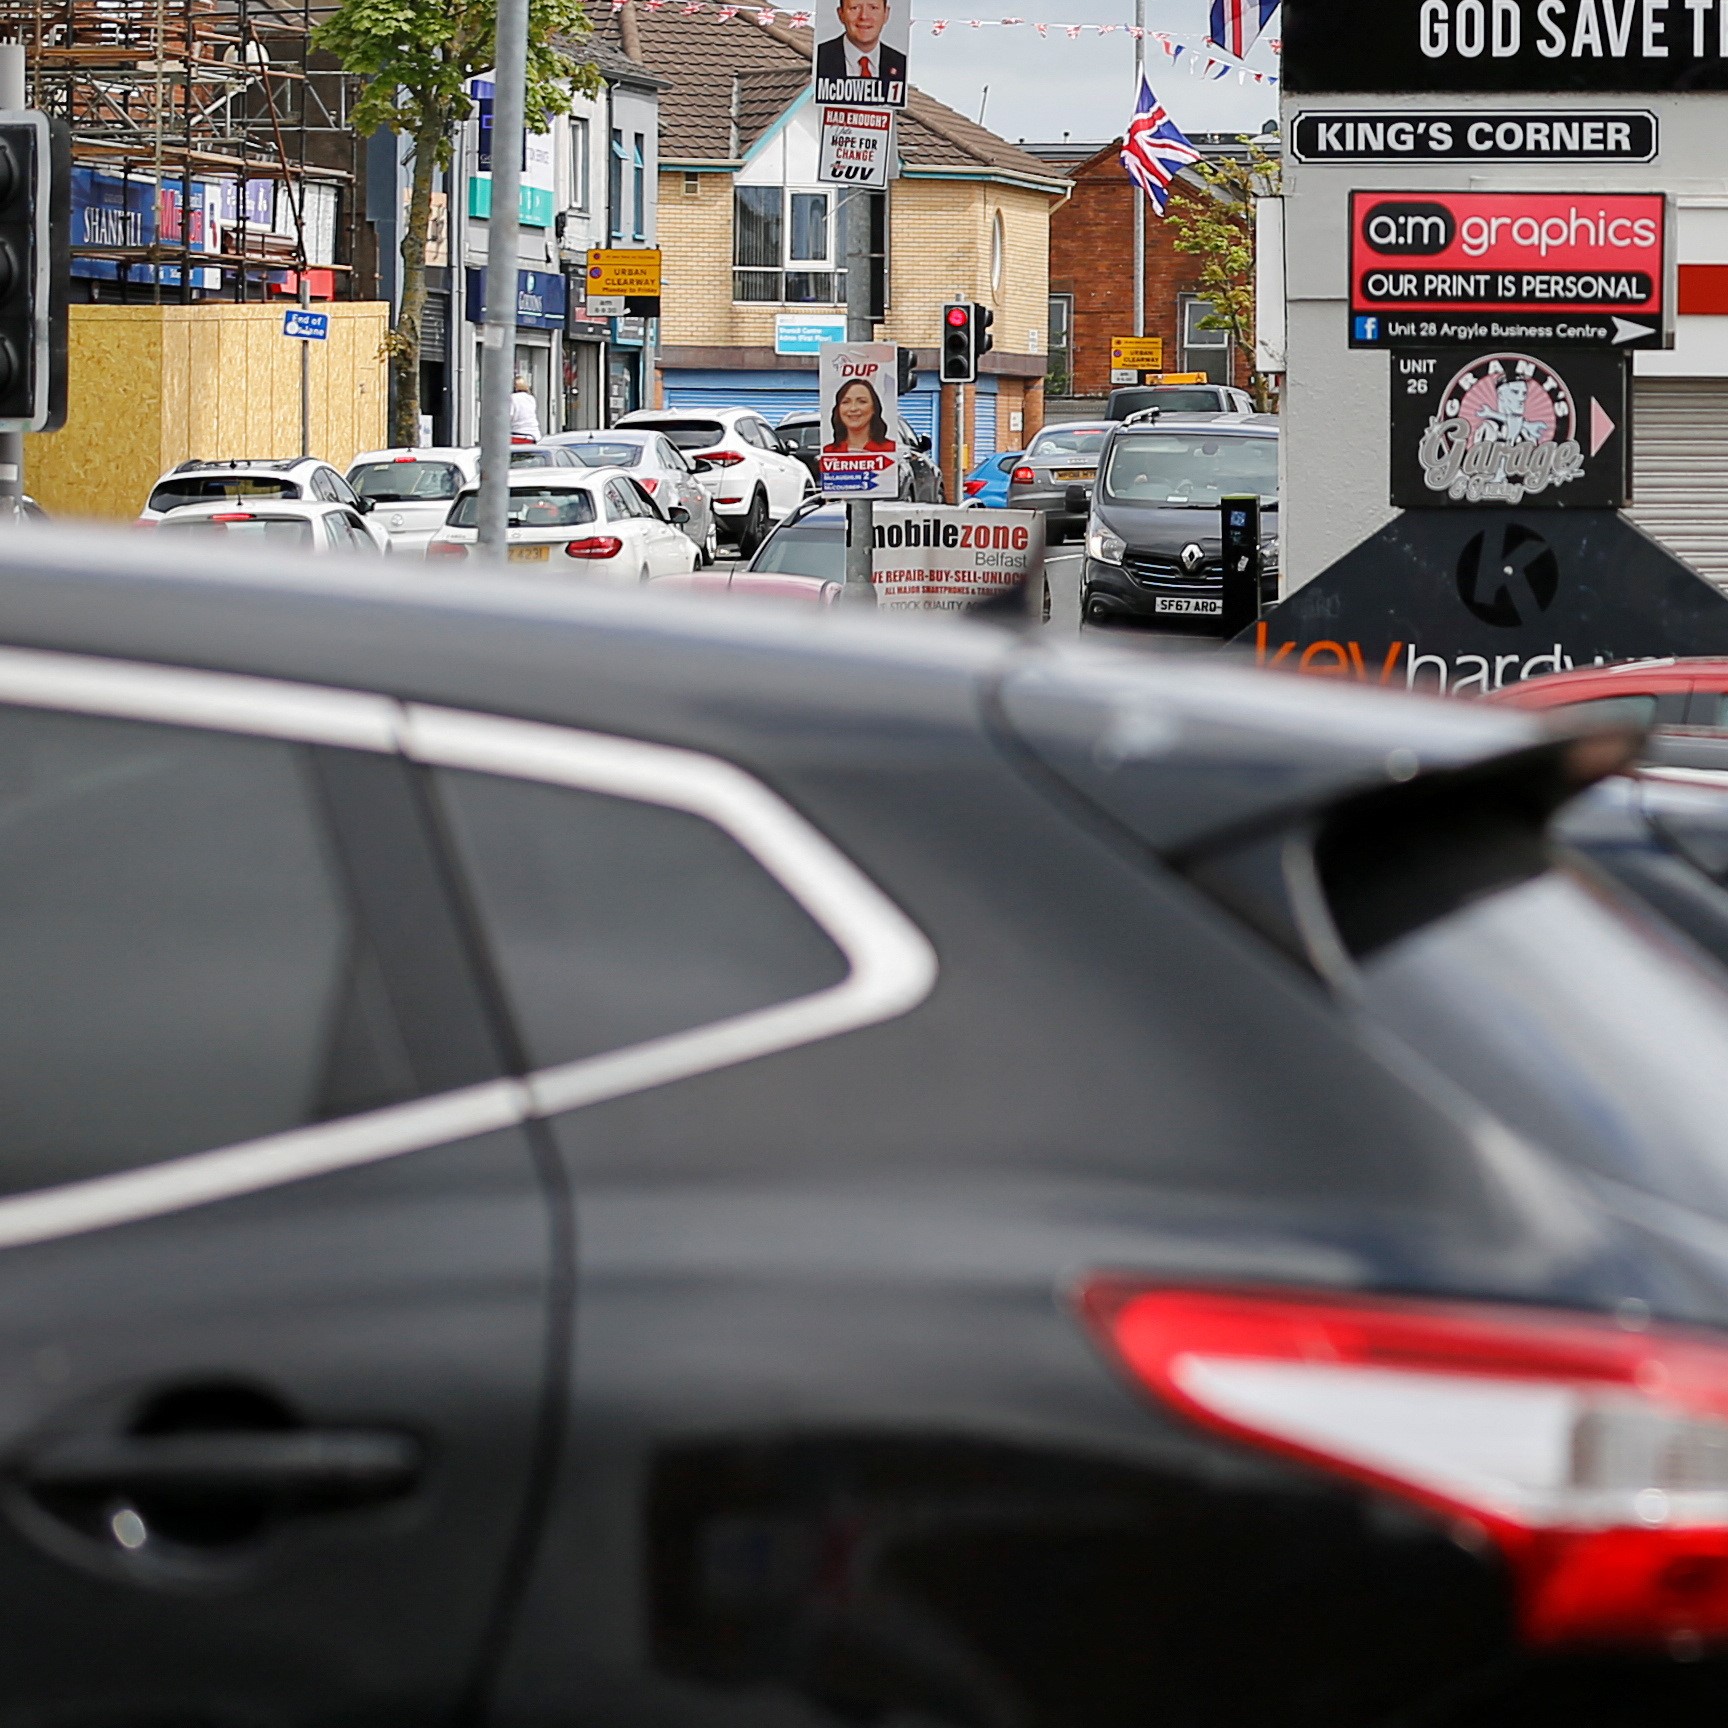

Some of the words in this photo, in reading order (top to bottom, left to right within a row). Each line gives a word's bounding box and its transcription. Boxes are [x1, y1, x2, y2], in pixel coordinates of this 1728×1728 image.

[817, 77, 886, 103] McDOWELL
[891, 82, 900, 102] 1
[826, 110, 845, 124] HAD
[847, 112, 888, 128] ENOUGH?
[831, 135, 856, 149] HOPE
[859, 137, 878, 151] FOR
[1317, 121, 1453, 152] KING’S
[1466, 121, 1631, 151] CORNER
[835, 148, 875, 162] CHANGE
[1461, 207, 1656, 257] graphics
[1367, 273, 1418, 297] OUR
[1424, 274, 1491, 297] PRINT
[1497, 274, 1516, 297] IS
[1521, 275, 1647, 300] PERSONAL
[1388, 322, 1417, 336] Unit
[1419, 322, 1437, 337] 28
[1439, 322, 1488, 339] Argyle
[1490, 322, 1553, 337] Business
[1555, 323, 1608, 338] Centre
[841, 363, 879, 377] DUP
[1399, 359, 1437, 374] UNIT
[1406, 378, 1428, 394] 26
[823, 460, 875, 471] VERNER
[875, 456, 884, 470] 1
[1417, 416, 1586, 495] Garage
[974, 551, 1028, 568] Belfast
[1160, 599, 1191, 612] SF67
